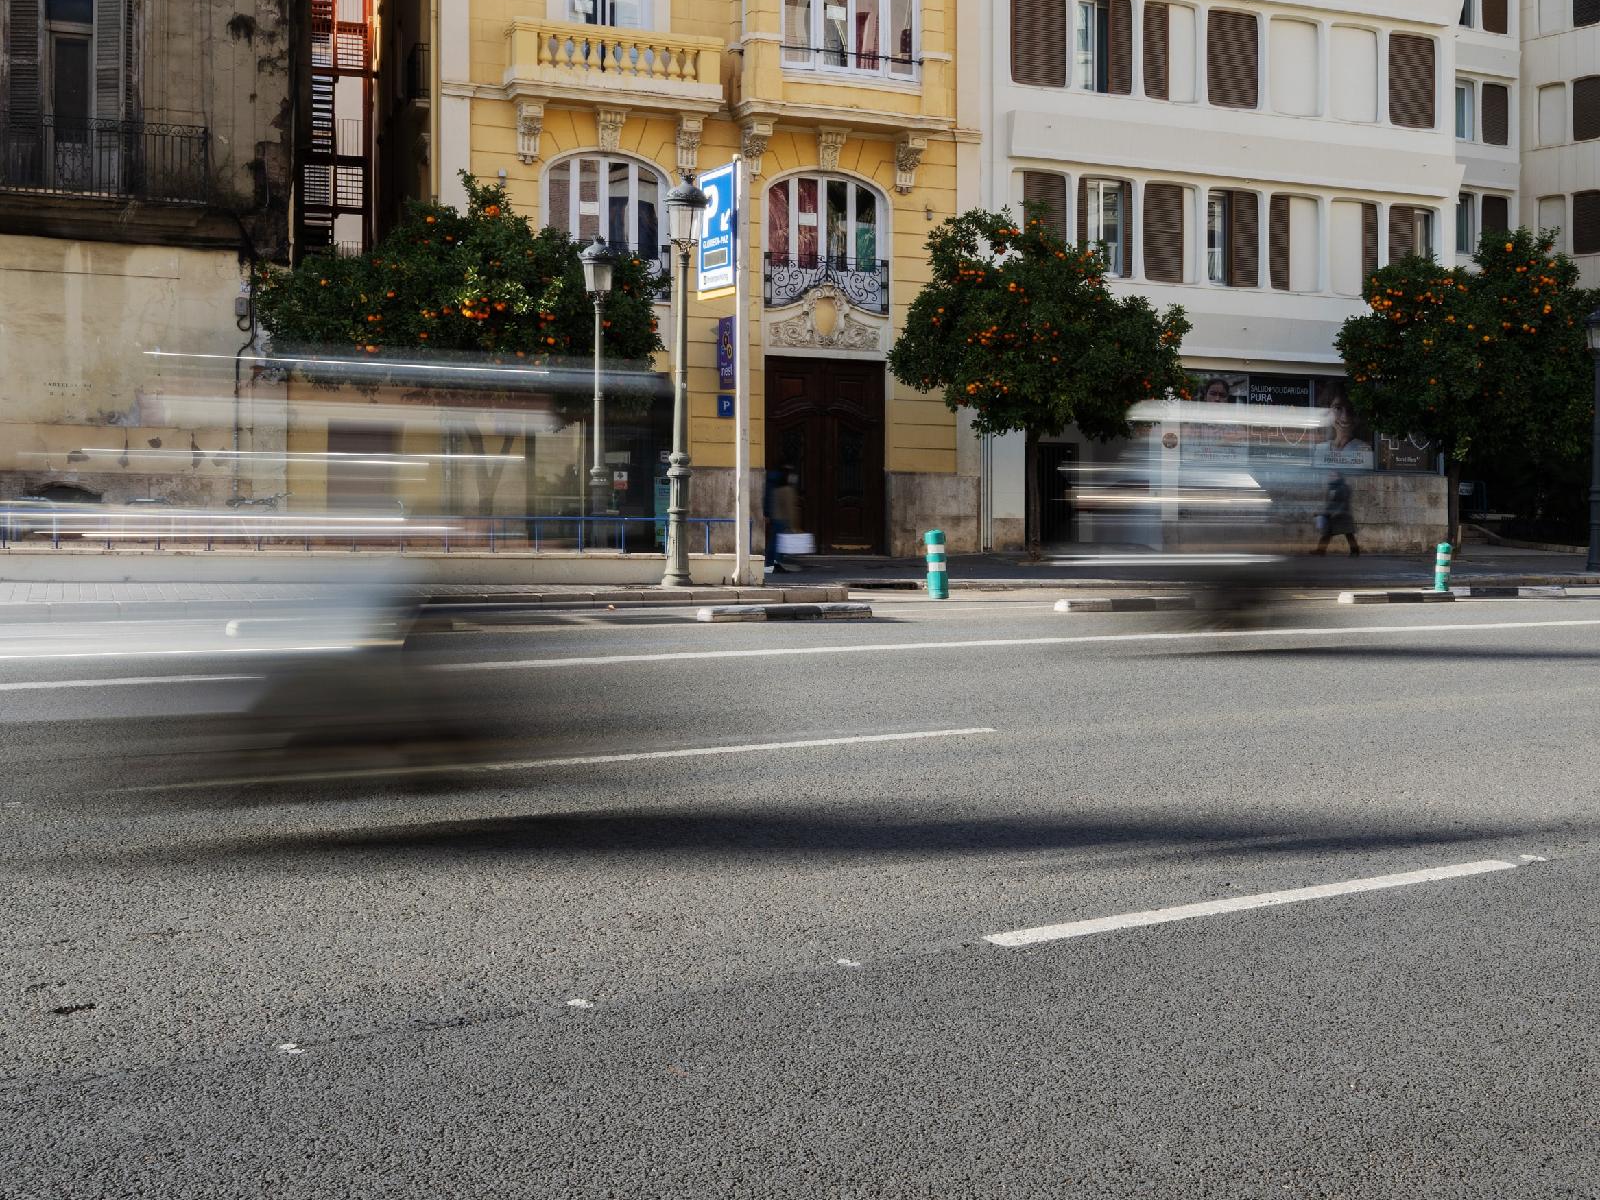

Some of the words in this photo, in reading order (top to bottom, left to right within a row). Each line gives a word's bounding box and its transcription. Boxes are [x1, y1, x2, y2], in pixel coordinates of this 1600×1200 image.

[702, 183, 719, 238] P
[1250, 393, 1273, 403] PURA
[722, 400, 731, 411] P
